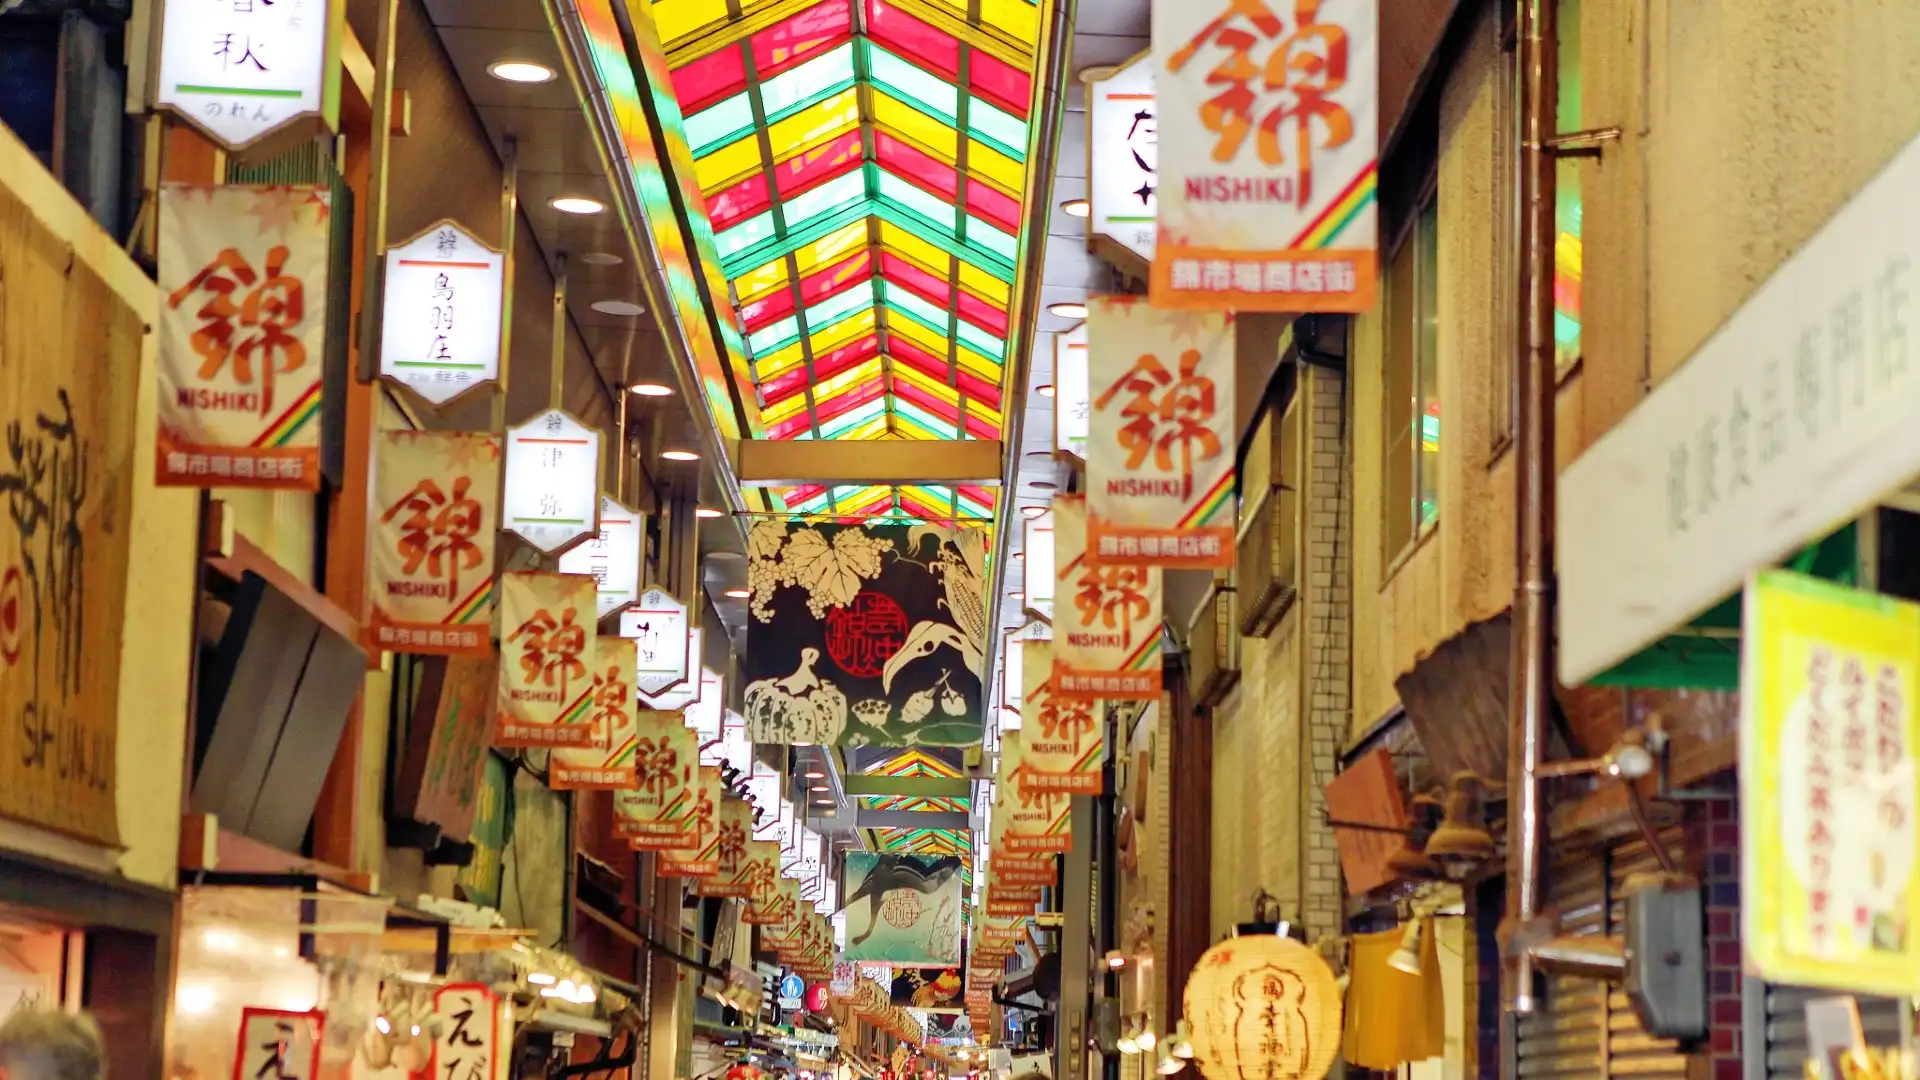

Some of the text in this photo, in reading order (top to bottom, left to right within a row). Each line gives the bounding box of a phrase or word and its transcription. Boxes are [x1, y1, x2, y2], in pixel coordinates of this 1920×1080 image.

[204, 101, 271, 122] のれん
[1165, 0, 1354, 213] 錦
[1185, 176, 1294, 203] NISHIKI
[1171, 259, 1356, 293] 錦市場商店街
[167, 245, 307, 420] 錦
[177, 387, 259, 413] NISHIKI
[1094, 348, 1223, 503] 錦
[166, 452, 305, 479] 錦市場商店街
[1106, 479, 1180, 498] NISHIKI
[380, 476, 484, 603] 錦
[1099, 535, 1221, 557] 錦市場商店街
[388, 580, 447, 599] NISHIKI
[379, 626, 479, 648] 錦市場商店街
[1067, 632, 1121, 649] NISHIKI
[506, 607, 587, 707] 錦
[511, 688, 558, 703] NISHIKI
[1031, 743, 1073, 755] NISHIKI
[1012, 812, 1046, 822] NISHIKI
